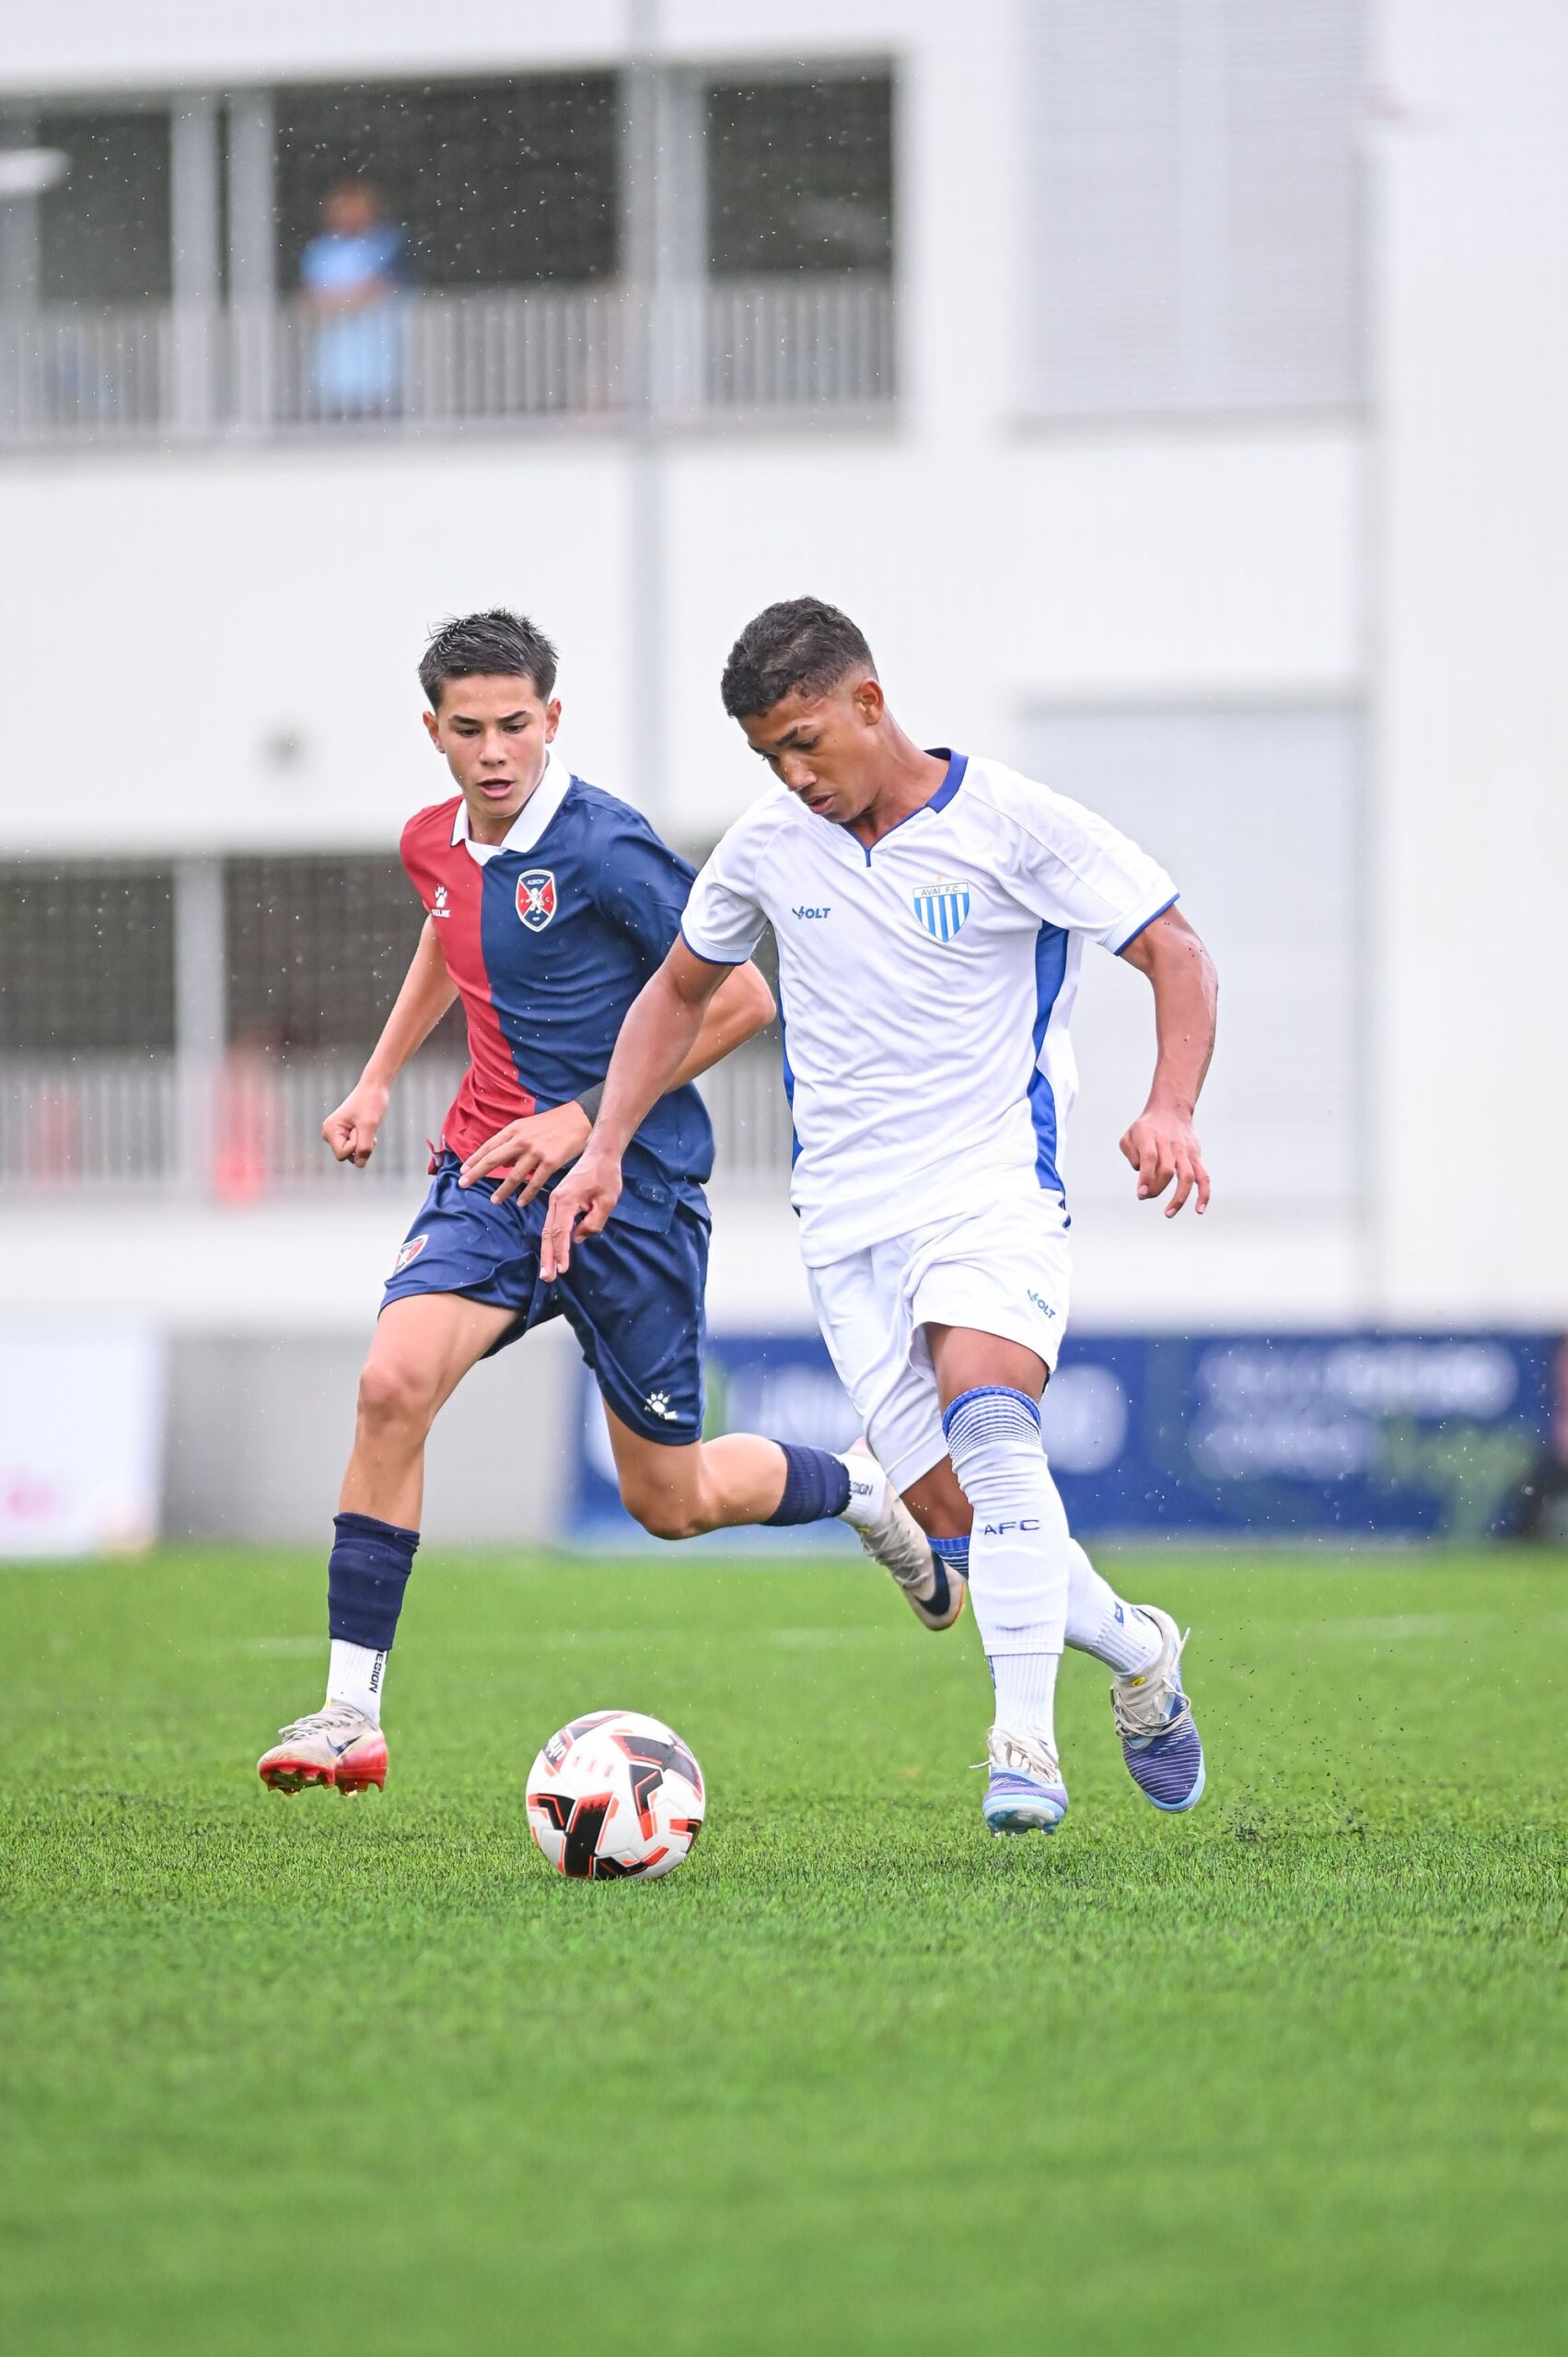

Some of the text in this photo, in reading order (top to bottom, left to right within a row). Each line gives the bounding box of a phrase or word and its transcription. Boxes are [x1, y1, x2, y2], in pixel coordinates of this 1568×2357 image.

[792, 906, 830, 920] VOLT
[1028, 1289, 1056, 1318] VOLT
[984, 1519, 1040, 1535] AFC
[369, 1650, 384, 1693] ESIGN
